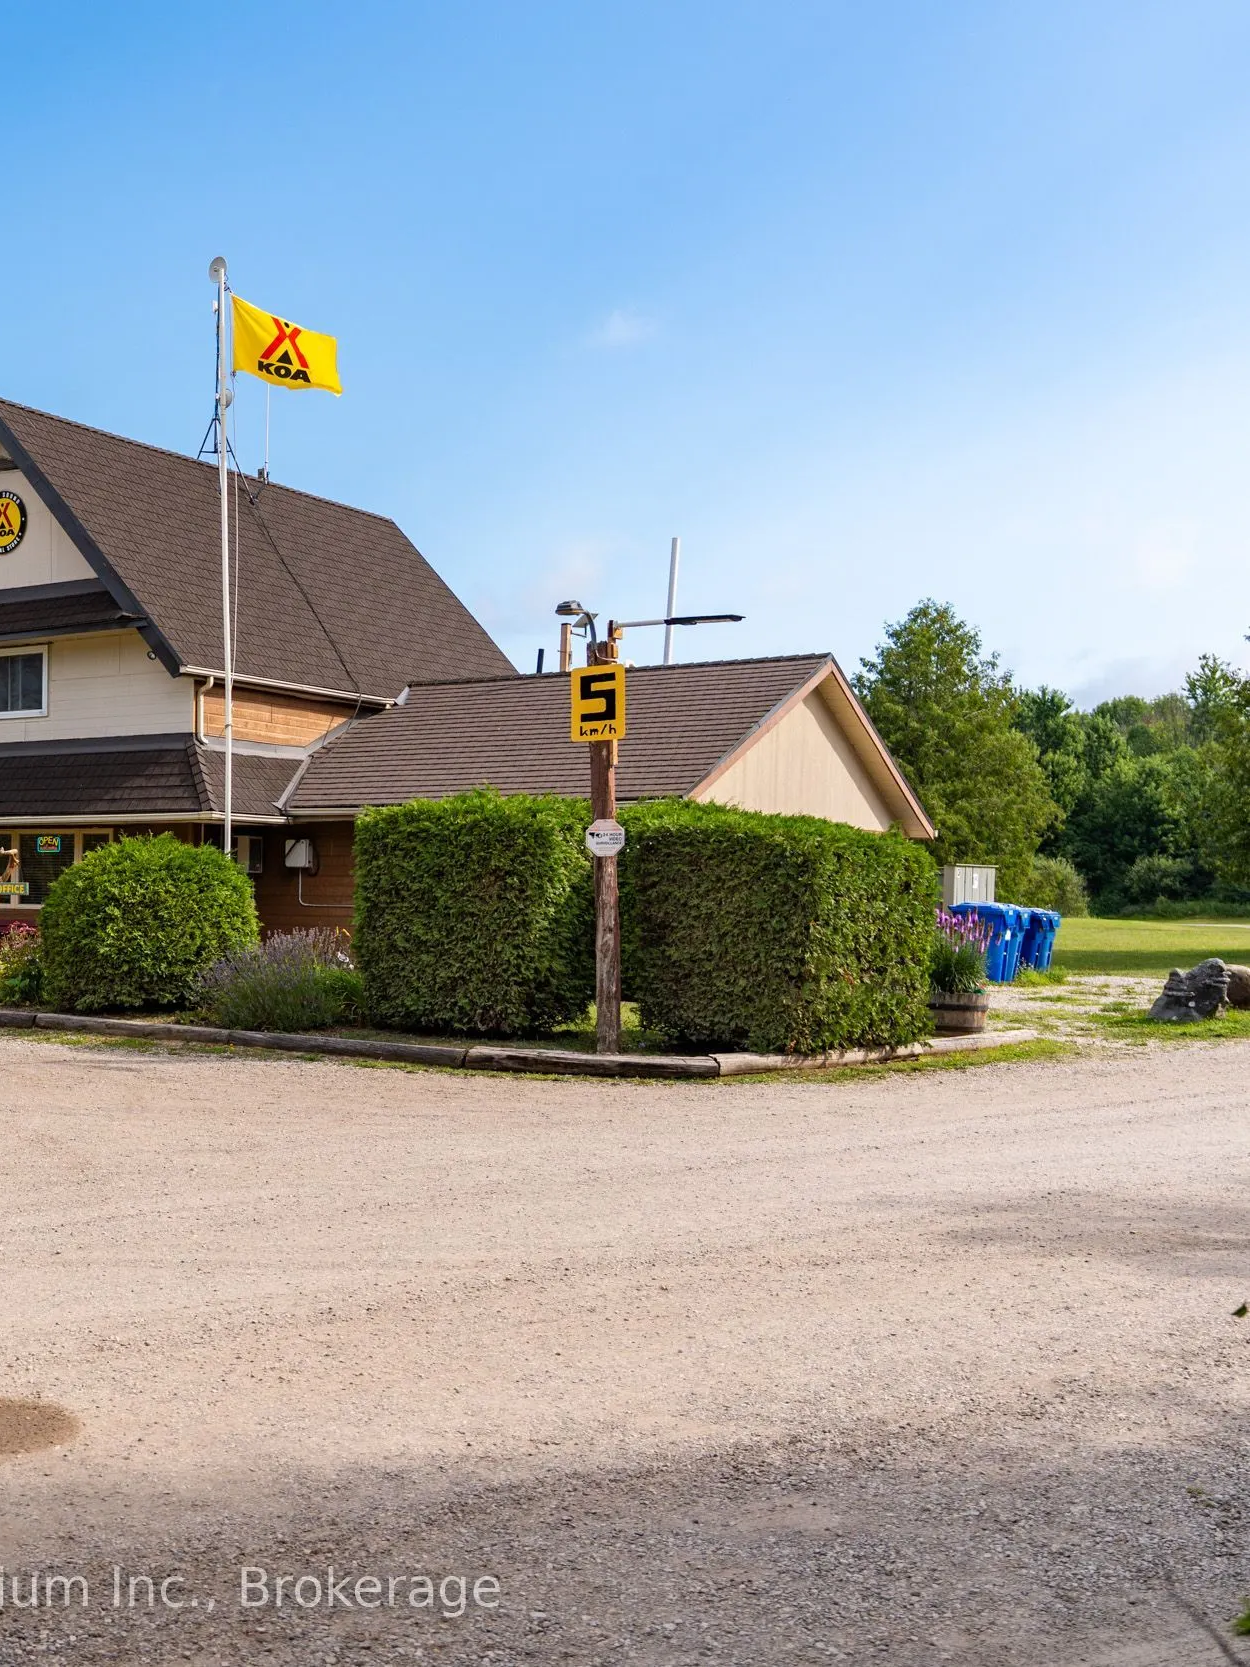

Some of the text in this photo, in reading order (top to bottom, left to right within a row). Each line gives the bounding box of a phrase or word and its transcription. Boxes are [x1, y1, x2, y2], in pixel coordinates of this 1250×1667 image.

[258, 360, 311, 384] KOA
[580, 672, 616, 722] 5
[579, 723, 617, 737] km/h
[39, 836, 58, 847] OPEN
